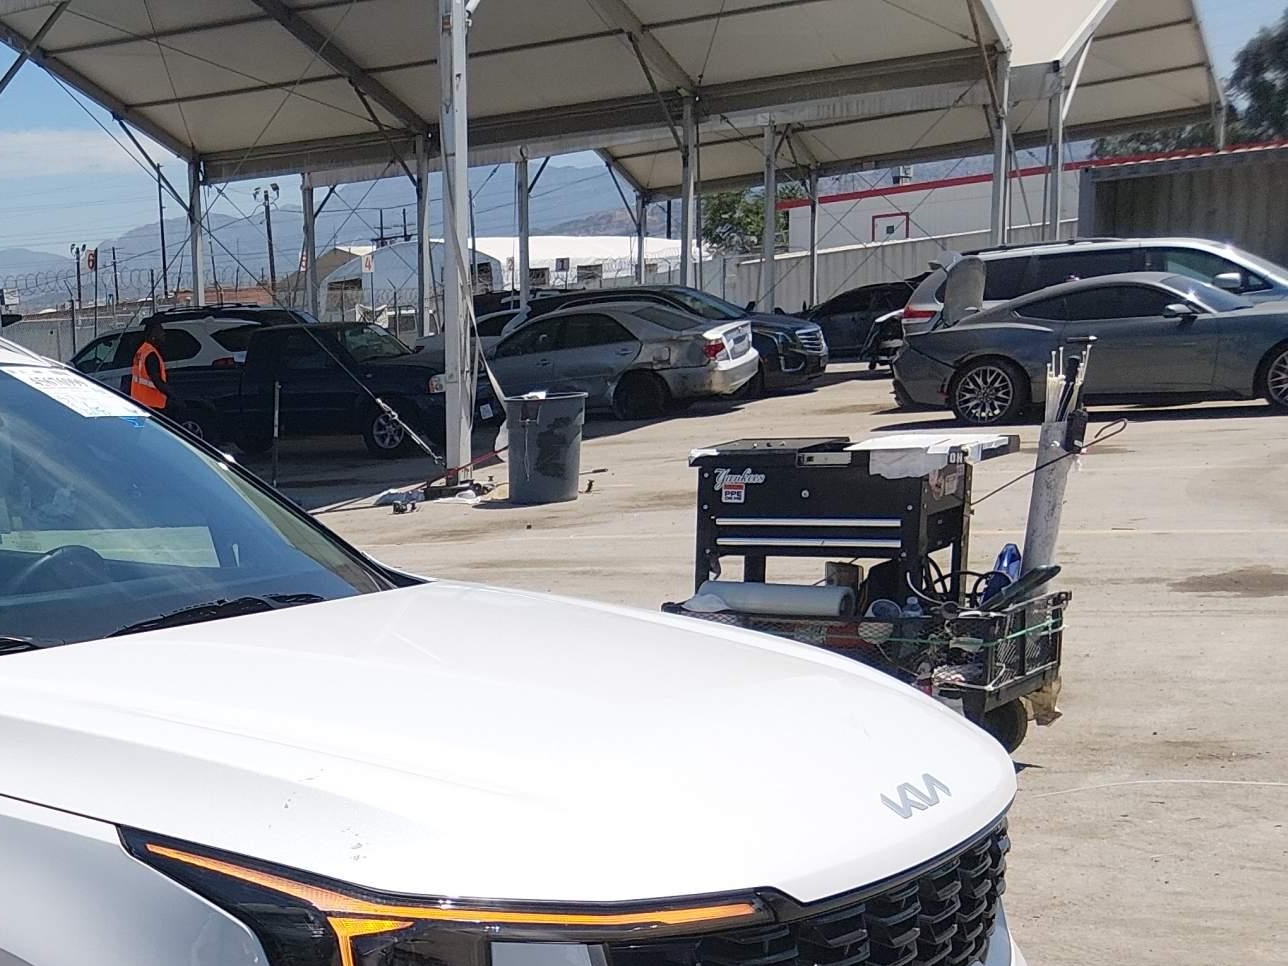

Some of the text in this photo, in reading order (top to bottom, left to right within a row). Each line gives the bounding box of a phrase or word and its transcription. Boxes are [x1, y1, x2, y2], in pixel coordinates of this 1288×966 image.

[87, 252, 96, 270] 6
[364, 256, 373, 272] 4
[714, 467, 766, 491] Yankees
